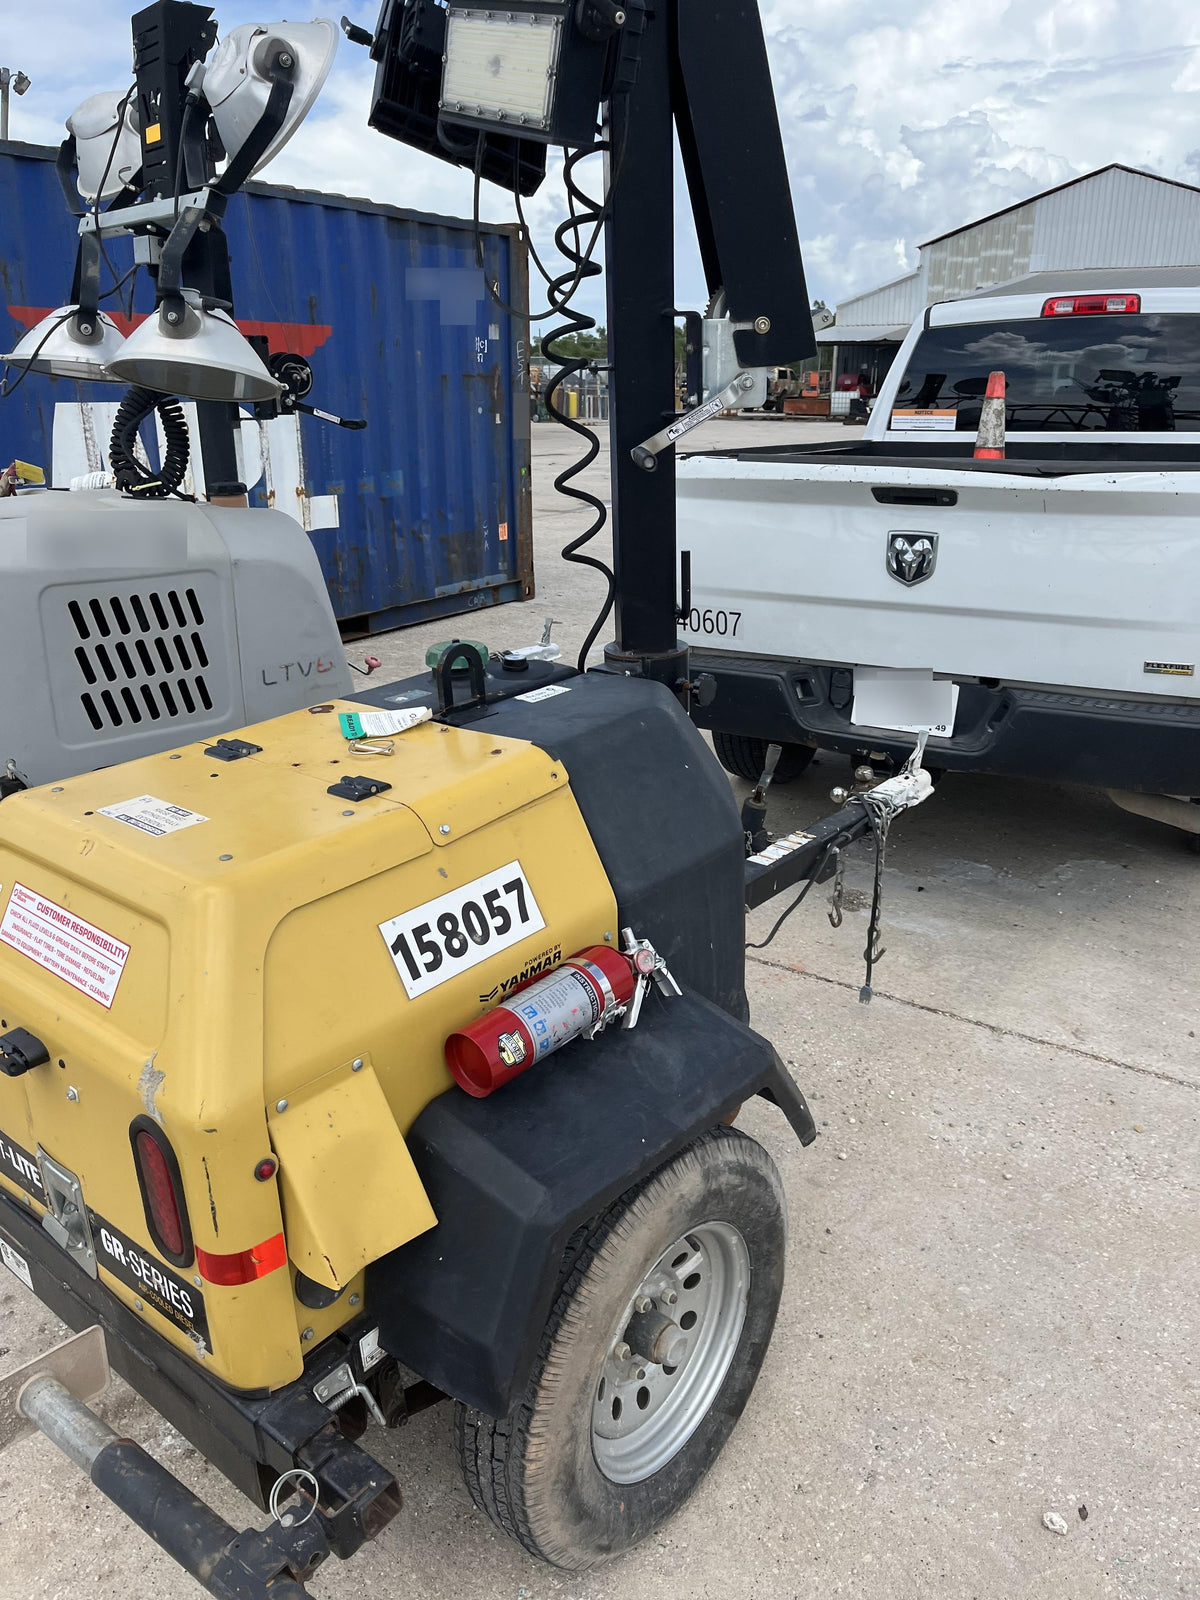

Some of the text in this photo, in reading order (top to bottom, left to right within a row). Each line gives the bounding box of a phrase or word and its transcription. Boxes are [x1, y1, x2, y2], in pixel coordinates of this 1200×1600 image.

[9, 908, 22, 920] CHECK
[27, 919, 40, 931] FLUID
[38, 925, 53, 938] LEVELS
[55, 935, 71, 949] GREASE
[69, 944, 82, 956] DAILY
[81, 951, 97, 965] BEFORE
[96, 960, 110, 973] START
[11, 922, 105, 985] INSURANCE FLAT TIRES TIRE DAMAGE REFUELING
[36, 901, 127, 960] CUSTOMER RESPONSIBILITY
[391, 877, 530, 981] 158057
[524, 944, 562, 968] POWERED BY
[20, 941, 42, 959] EQUIPMENT
[43, 955, 60, 970] BATTERY
[59, 964, 88, 988] MAINTENANCE
[88, 983, 110, 1002] CLEANING
[500, 950, 562, 993] YANMAR
[100, 1227, 194, 1319] GR-SERIES
